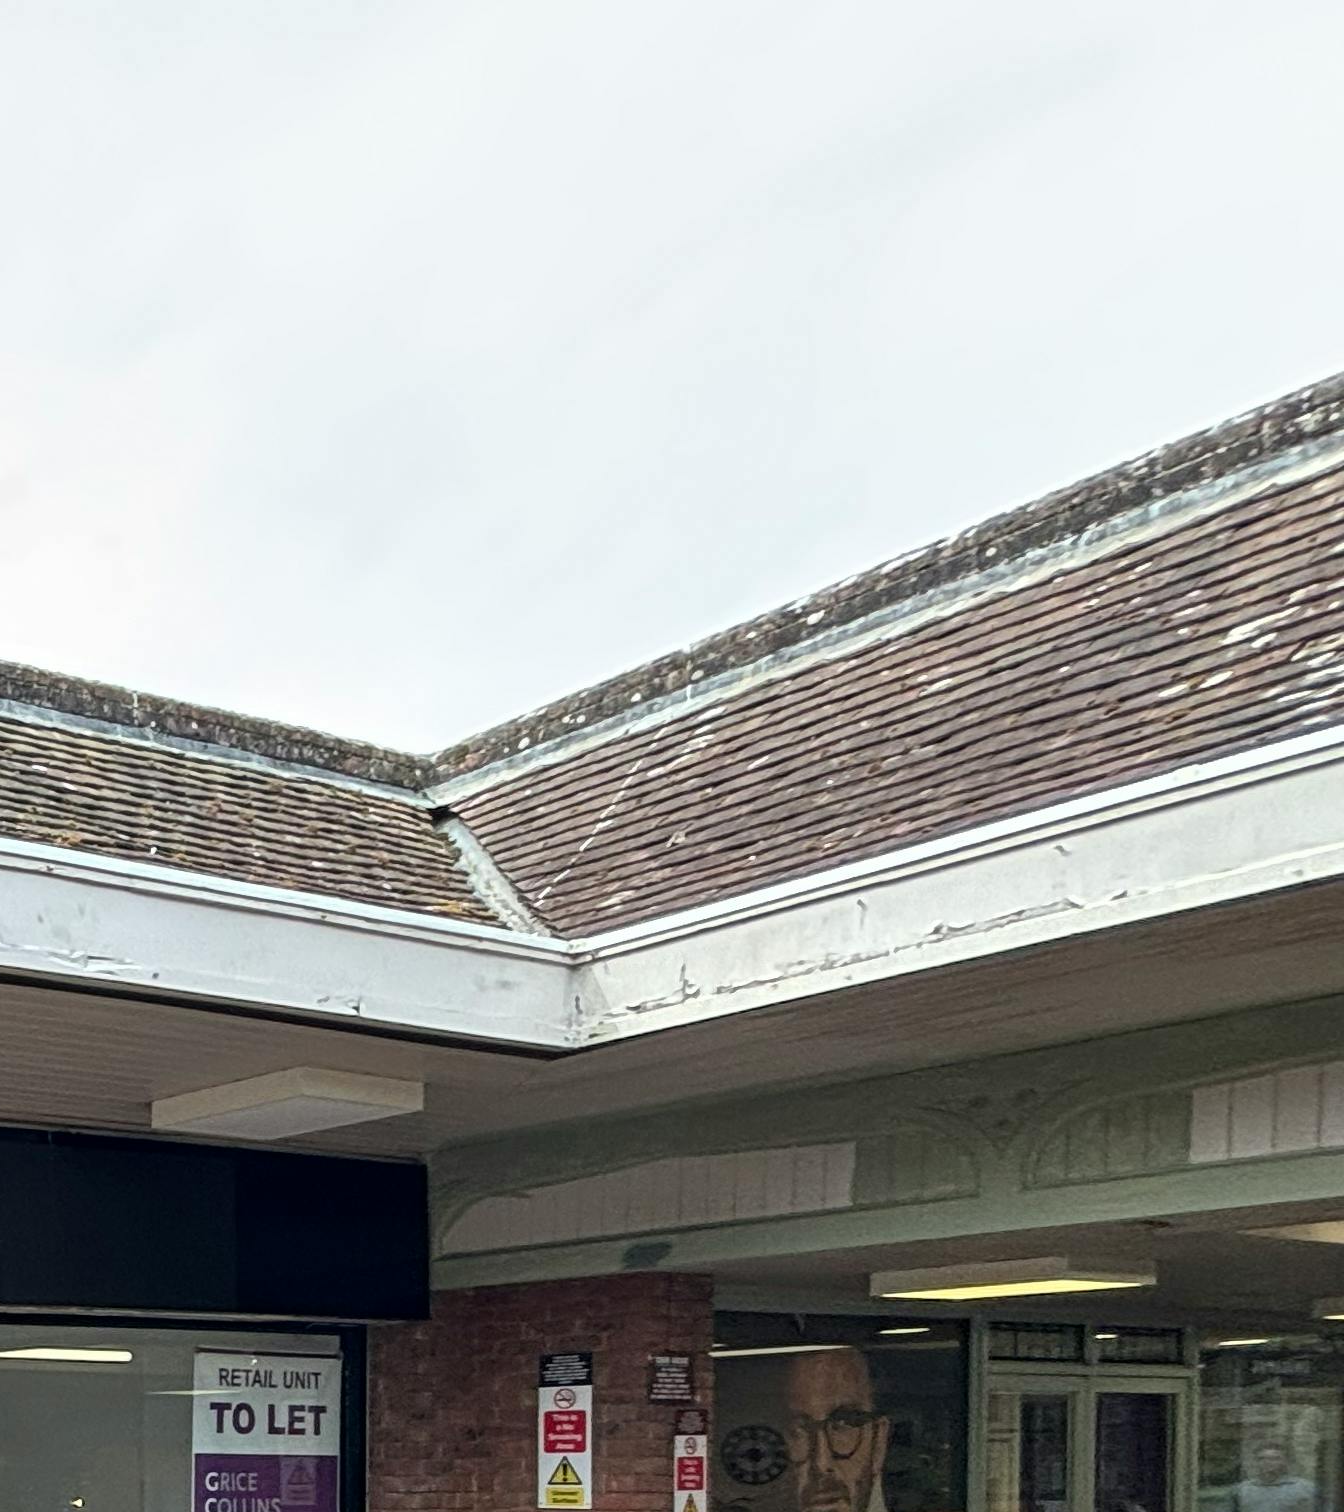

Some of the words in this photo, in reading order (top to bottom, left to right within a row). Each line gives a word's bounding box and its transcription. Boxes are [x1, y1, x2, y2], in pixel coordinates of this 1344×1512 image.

[219, 1368, 277, 1388] RETAIL
[283, 1371, 321, 1390] UNIT
[209, 1402, 256, 1434] TO
[267, 1404, 327, 1435] LET
[205, 1472, 258, 1492] GRICE
